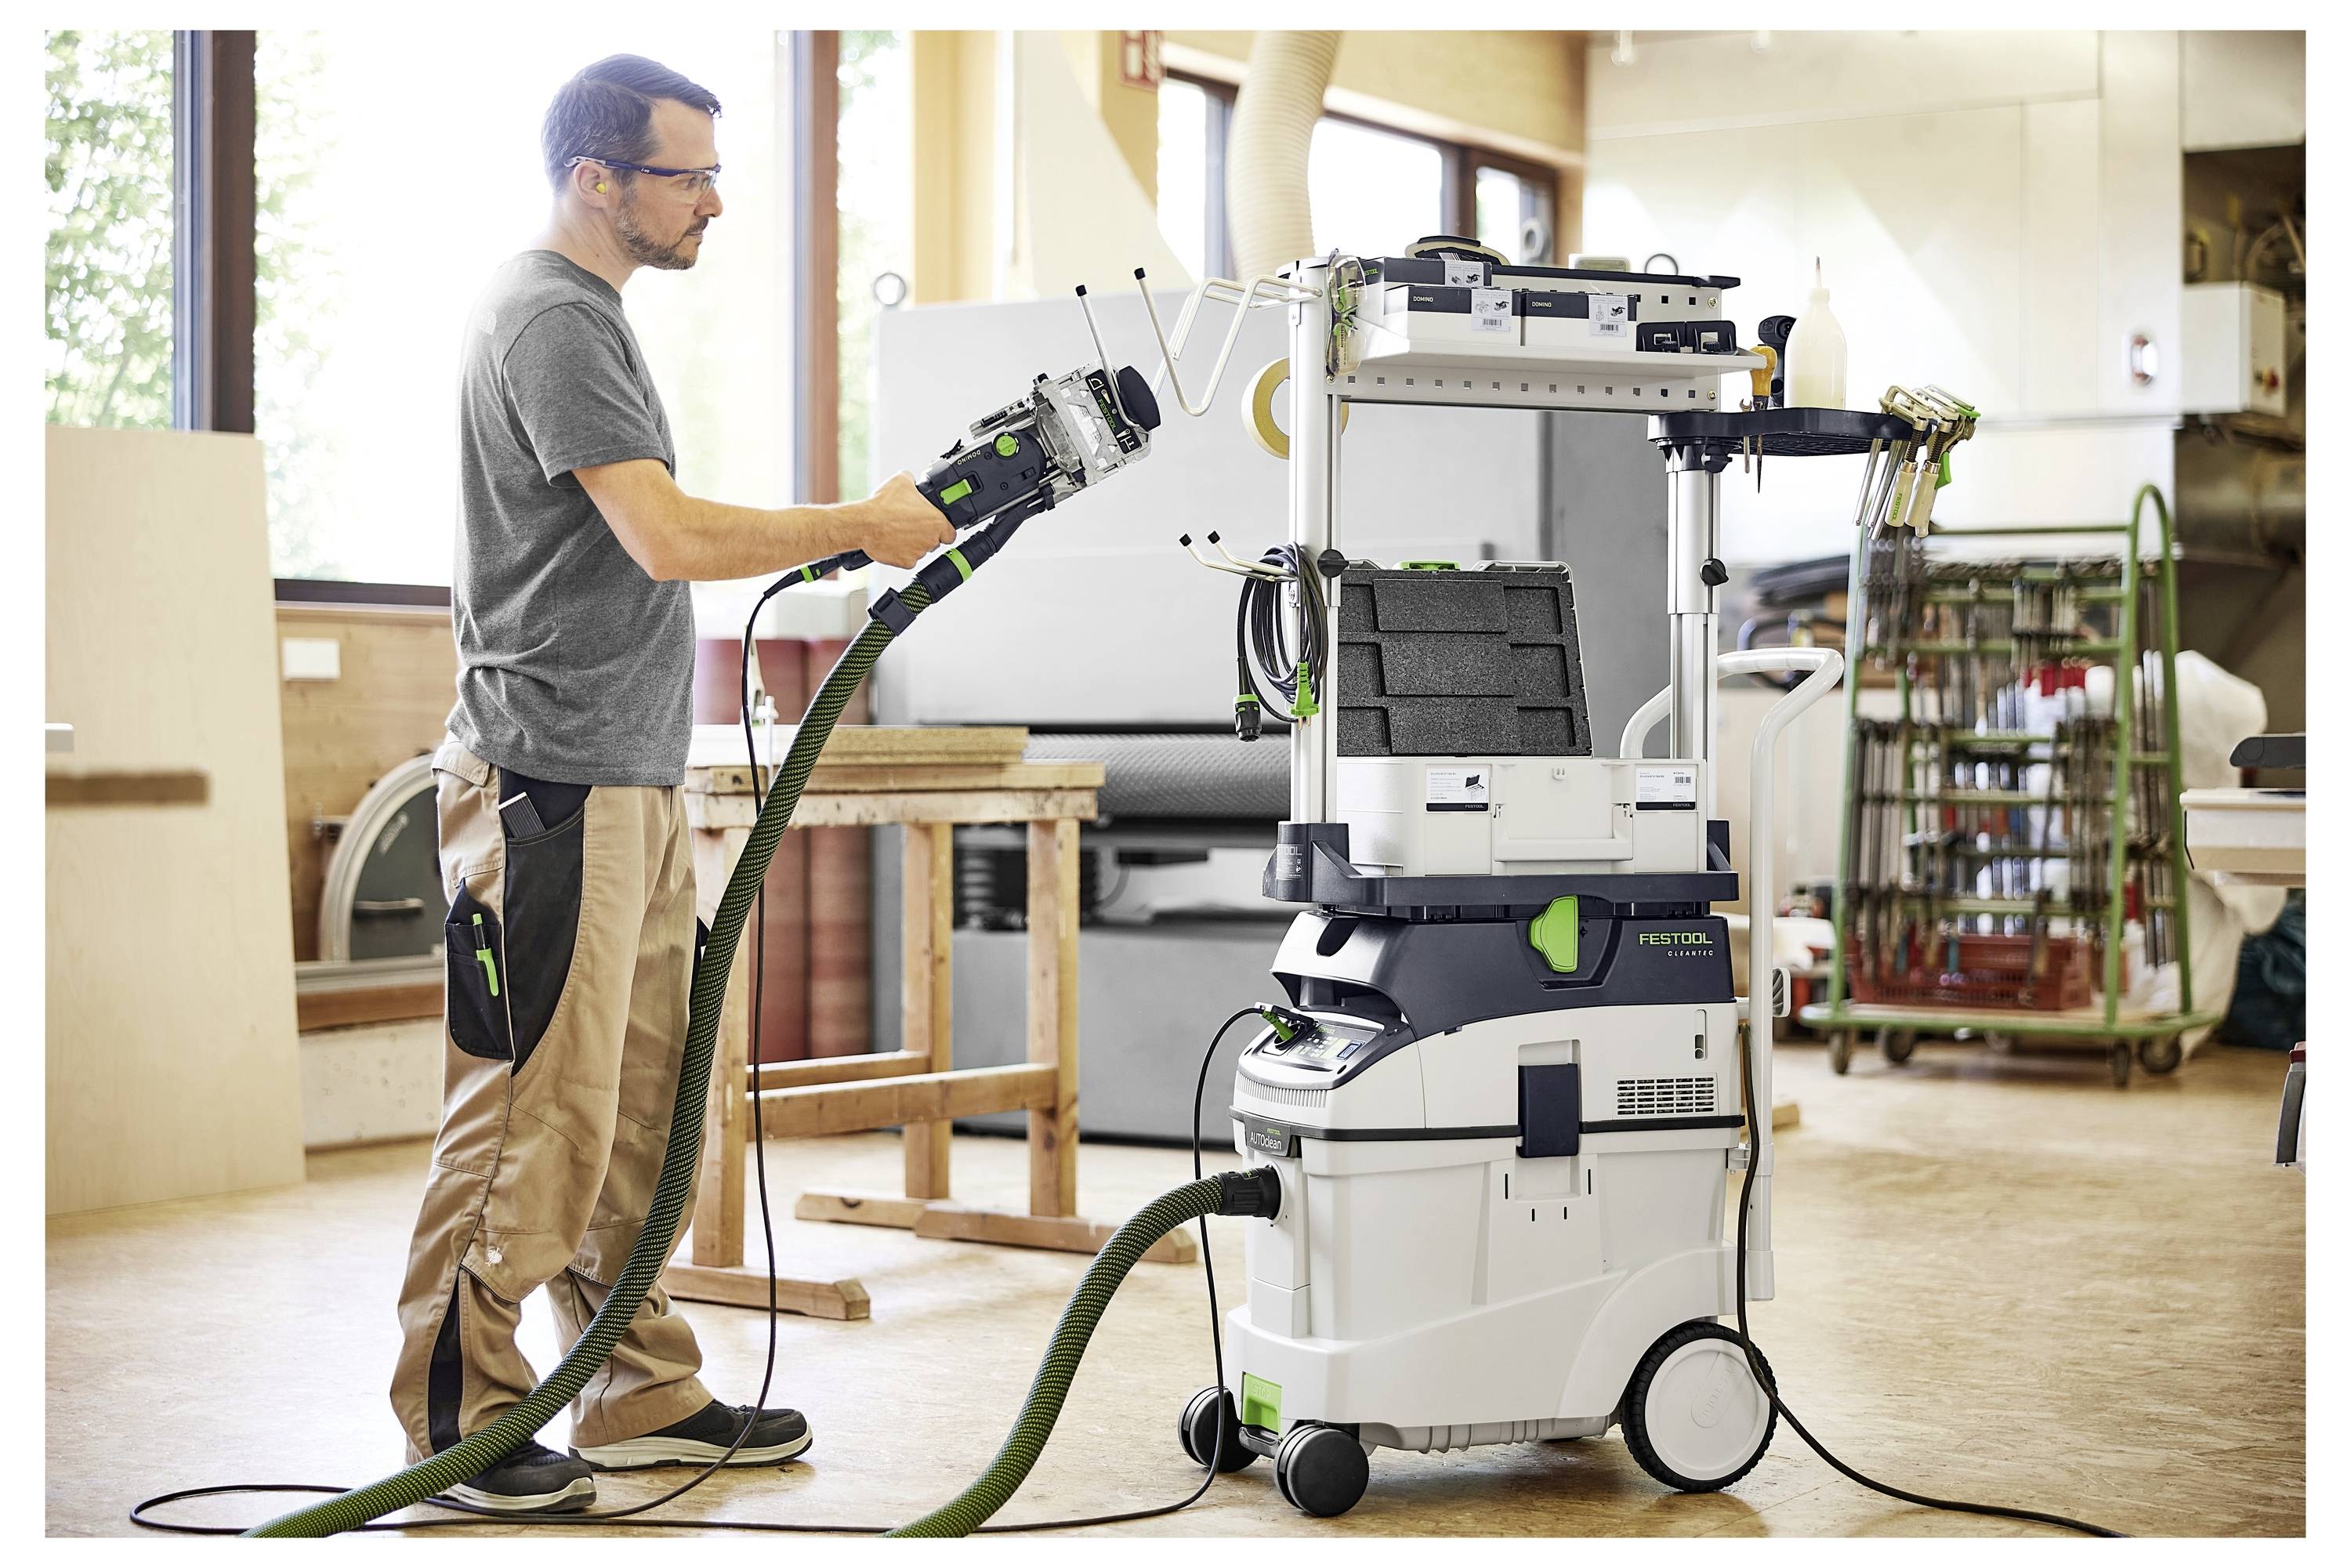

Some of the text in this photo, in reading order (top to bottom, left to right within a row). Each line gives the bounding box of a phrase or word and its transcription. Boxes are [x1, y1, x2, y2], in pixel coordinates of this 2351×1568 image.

[1098, 399, 1117, 432] FESTOOL
[957, 450, 980, 465] DOMINO
[1892, 493, 1903, 521] FESTOOL
[1639, 932, 1713, 945] FESTOOL
[1250, 1132, 1282, 1150] AUTOclean
